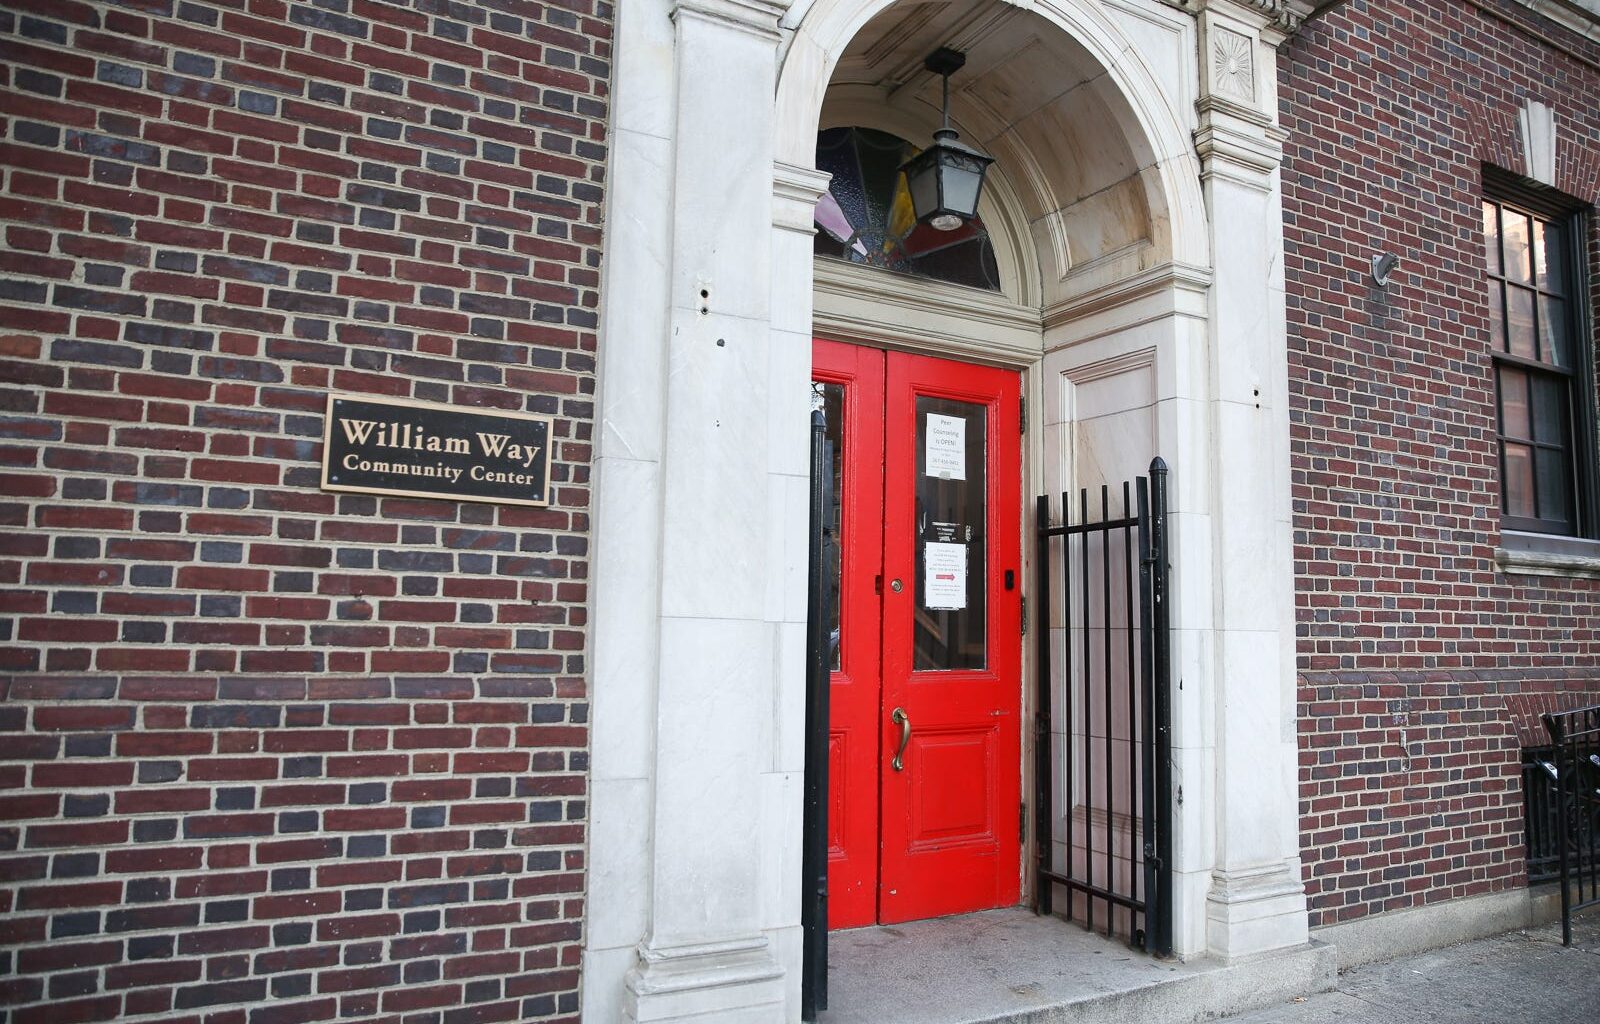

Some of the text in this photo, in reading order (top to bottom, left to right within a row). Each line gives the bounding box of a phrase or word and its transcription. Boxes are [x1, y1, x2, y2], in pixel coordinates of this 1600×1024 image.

[338, 418, 541, 468] William Way
[342, 454, 534, 485] Community Center
